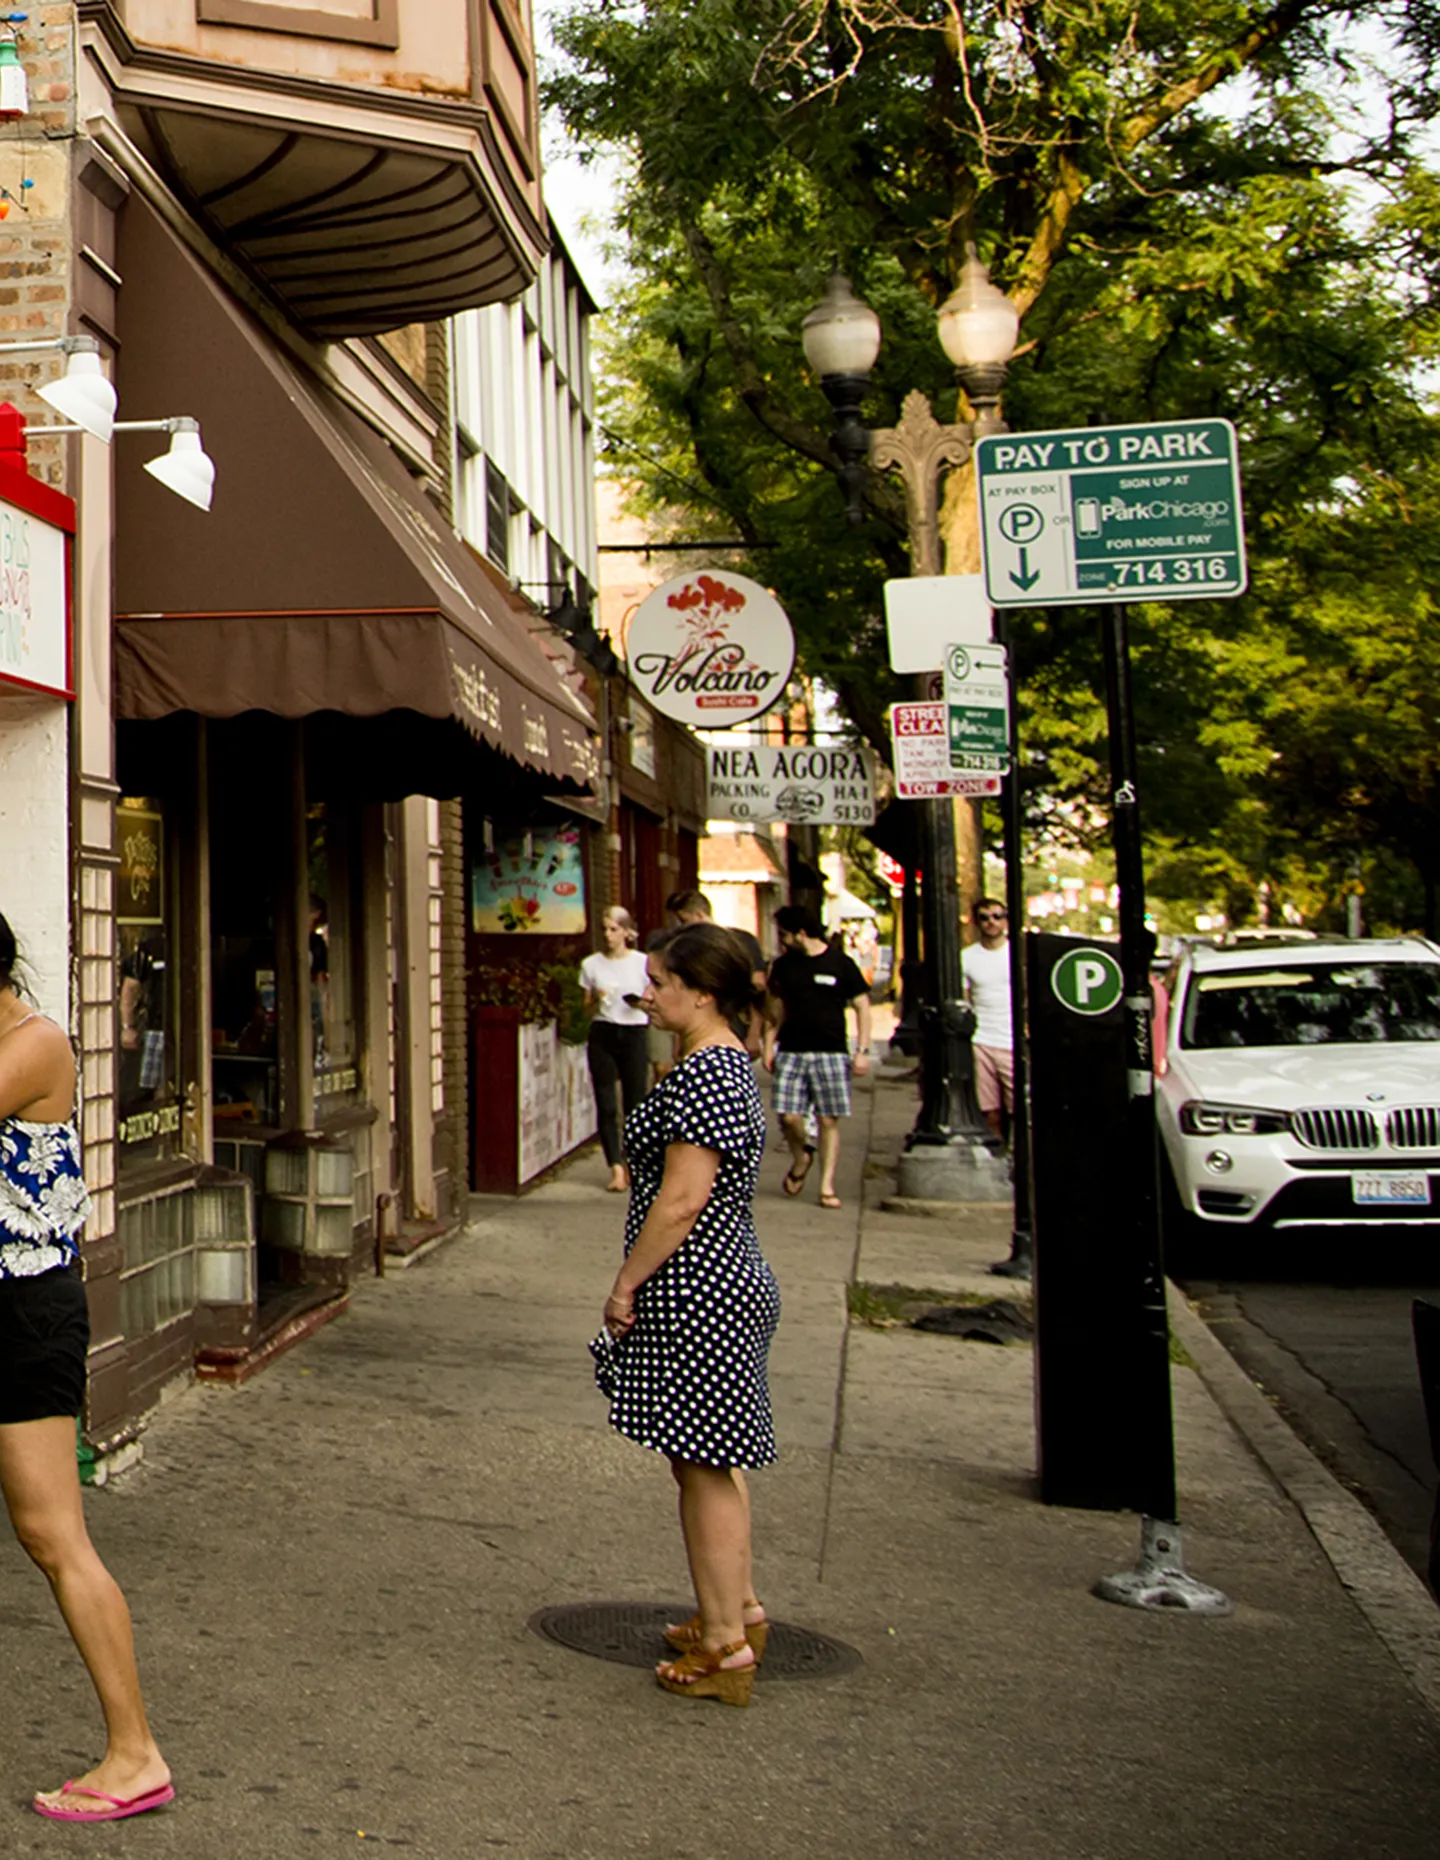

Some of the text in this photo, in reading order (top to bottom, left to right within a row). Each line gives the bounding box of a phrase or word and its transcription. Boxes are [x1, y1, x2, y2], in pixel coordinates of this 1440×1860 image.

[995, 431, 1212, 469] PAY TO PARK
[988, 484, 1057, 498] AT PAY BOX
[1119, 475, 1190, 490] SIGN UP AT
[1101, 500, 1229, 522] ParkChicago
[1052, 515, 1070, 526] OR
[1106, 534, 1212, 550] FOR MOBILE PAY
[1079, 558, 1227, 584] ZONE 714 316
[634, 643, 780, 696] Volcano
[712, 750, 868, 781] NEA AGORA
[710, 783, 770, 798] PACKING
[906, 780, 986, 795] TOW ZONE
[833, 803, 871, 820] 5130
[1073, 960, 1108, 1004] P
